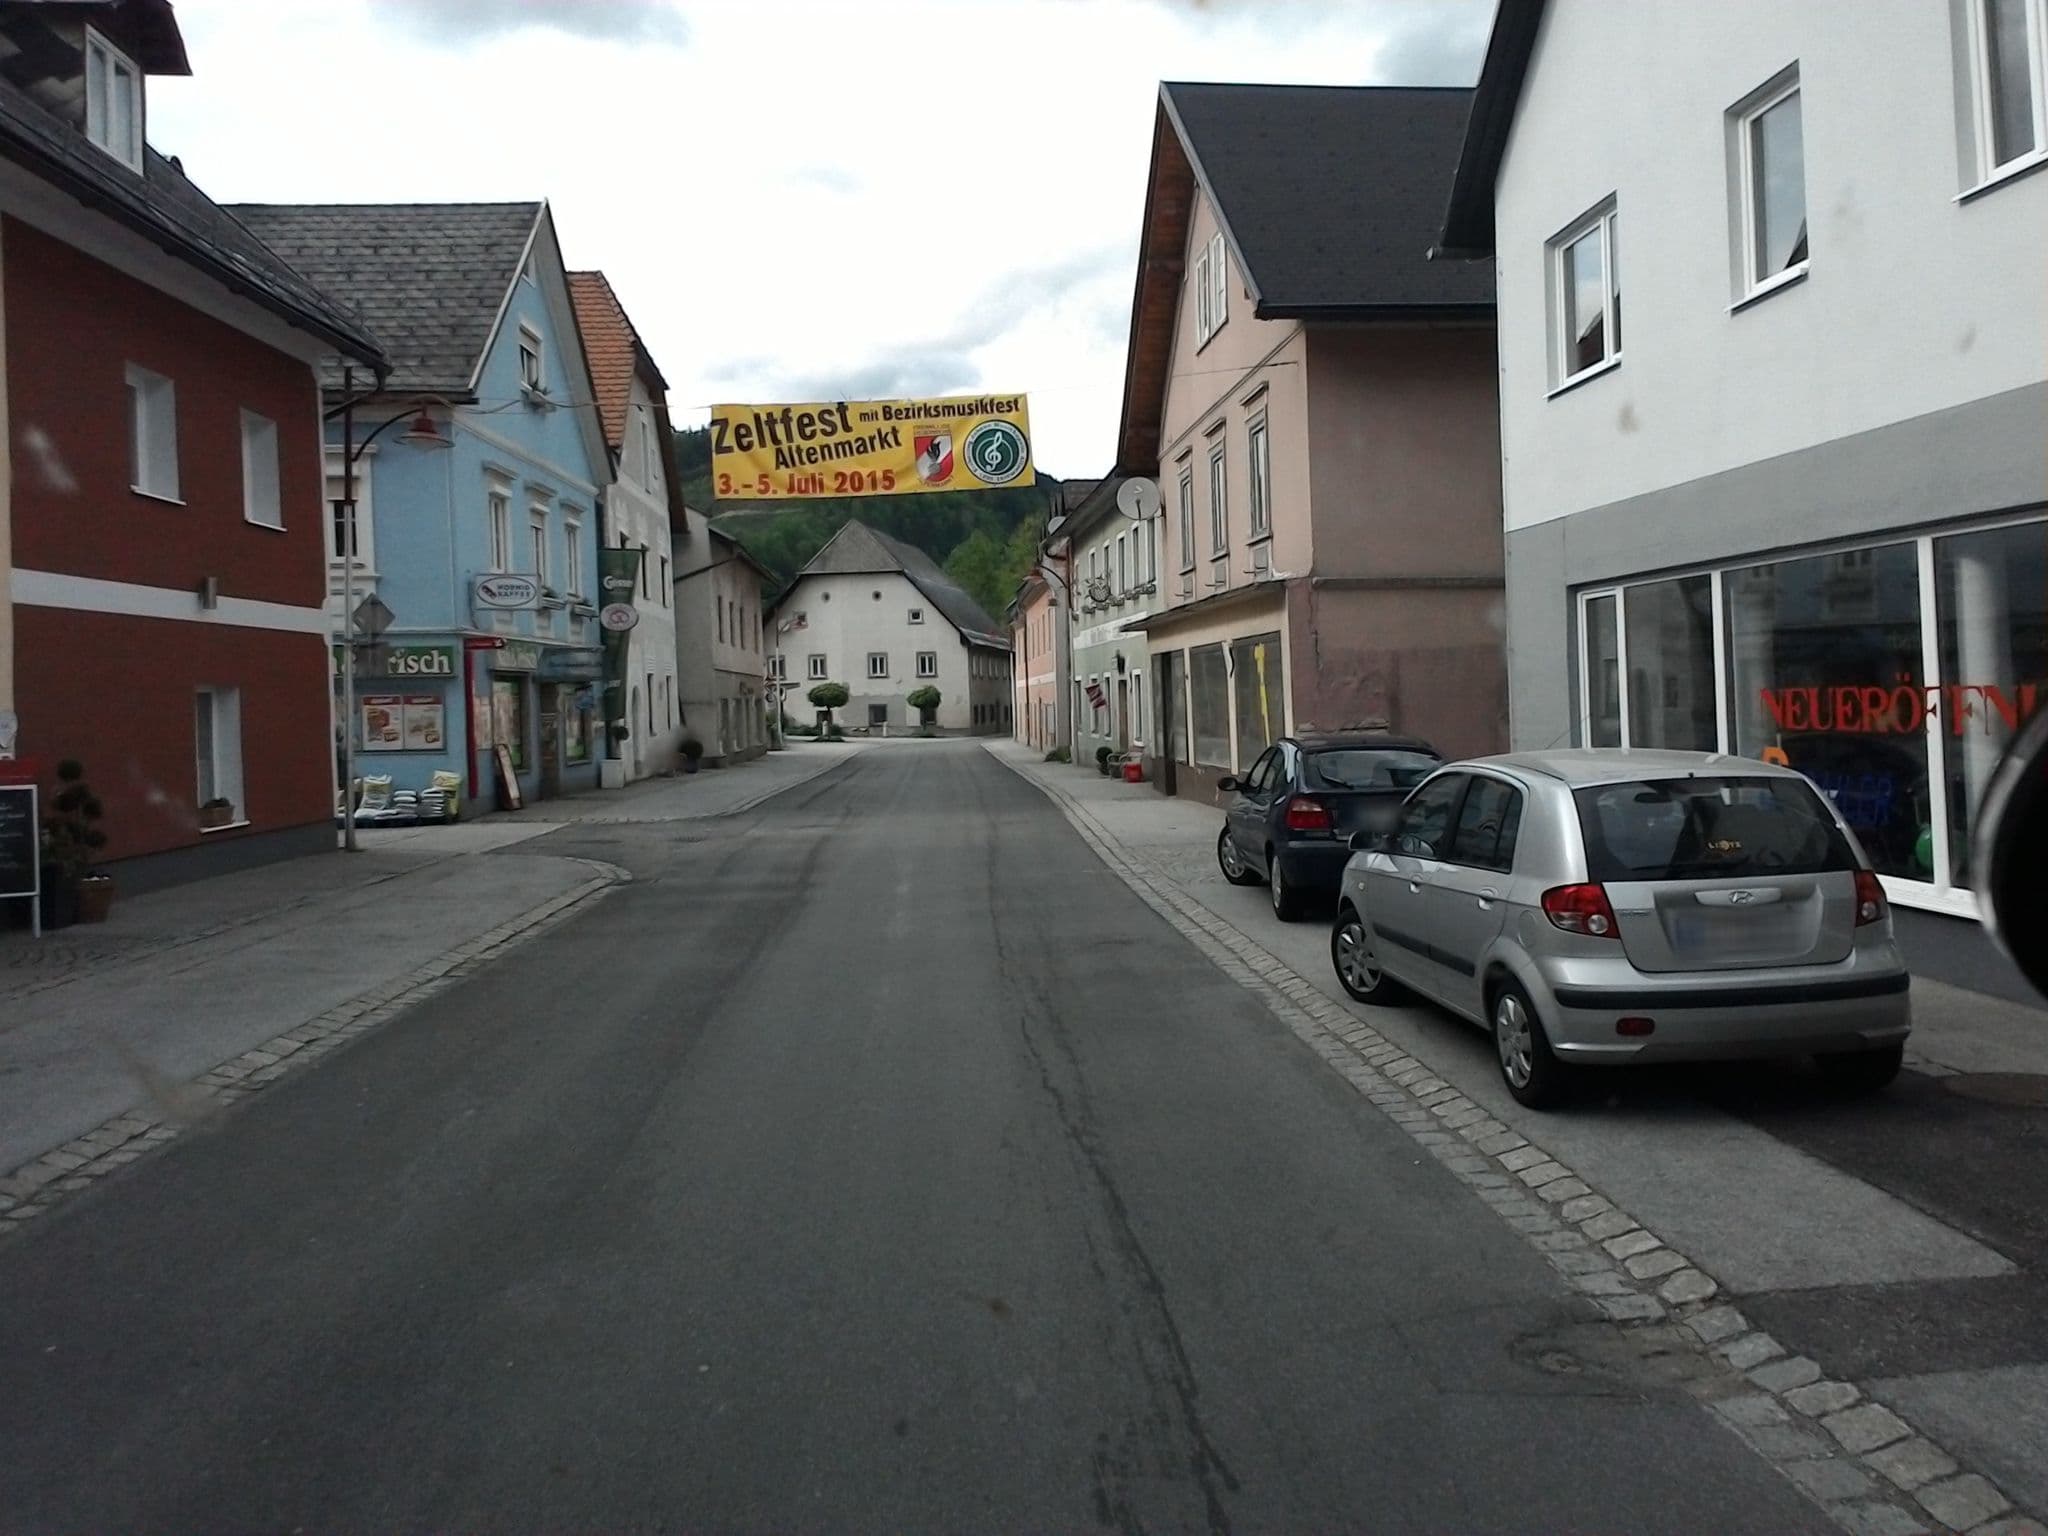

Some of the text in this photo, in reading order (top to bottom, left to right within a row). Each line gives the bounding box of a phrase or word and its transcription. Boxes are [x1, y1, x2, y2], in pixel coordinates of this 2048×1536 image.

[711, 398, 1020, 455] Zeltfest mit Bezirksmusikfest
[775, 426, 902, 470] Altenmarkt
[787, 472, 825, 494] Juli
[834, 469, 896, 493] 2015
[387, 649, 451, 674] risch
